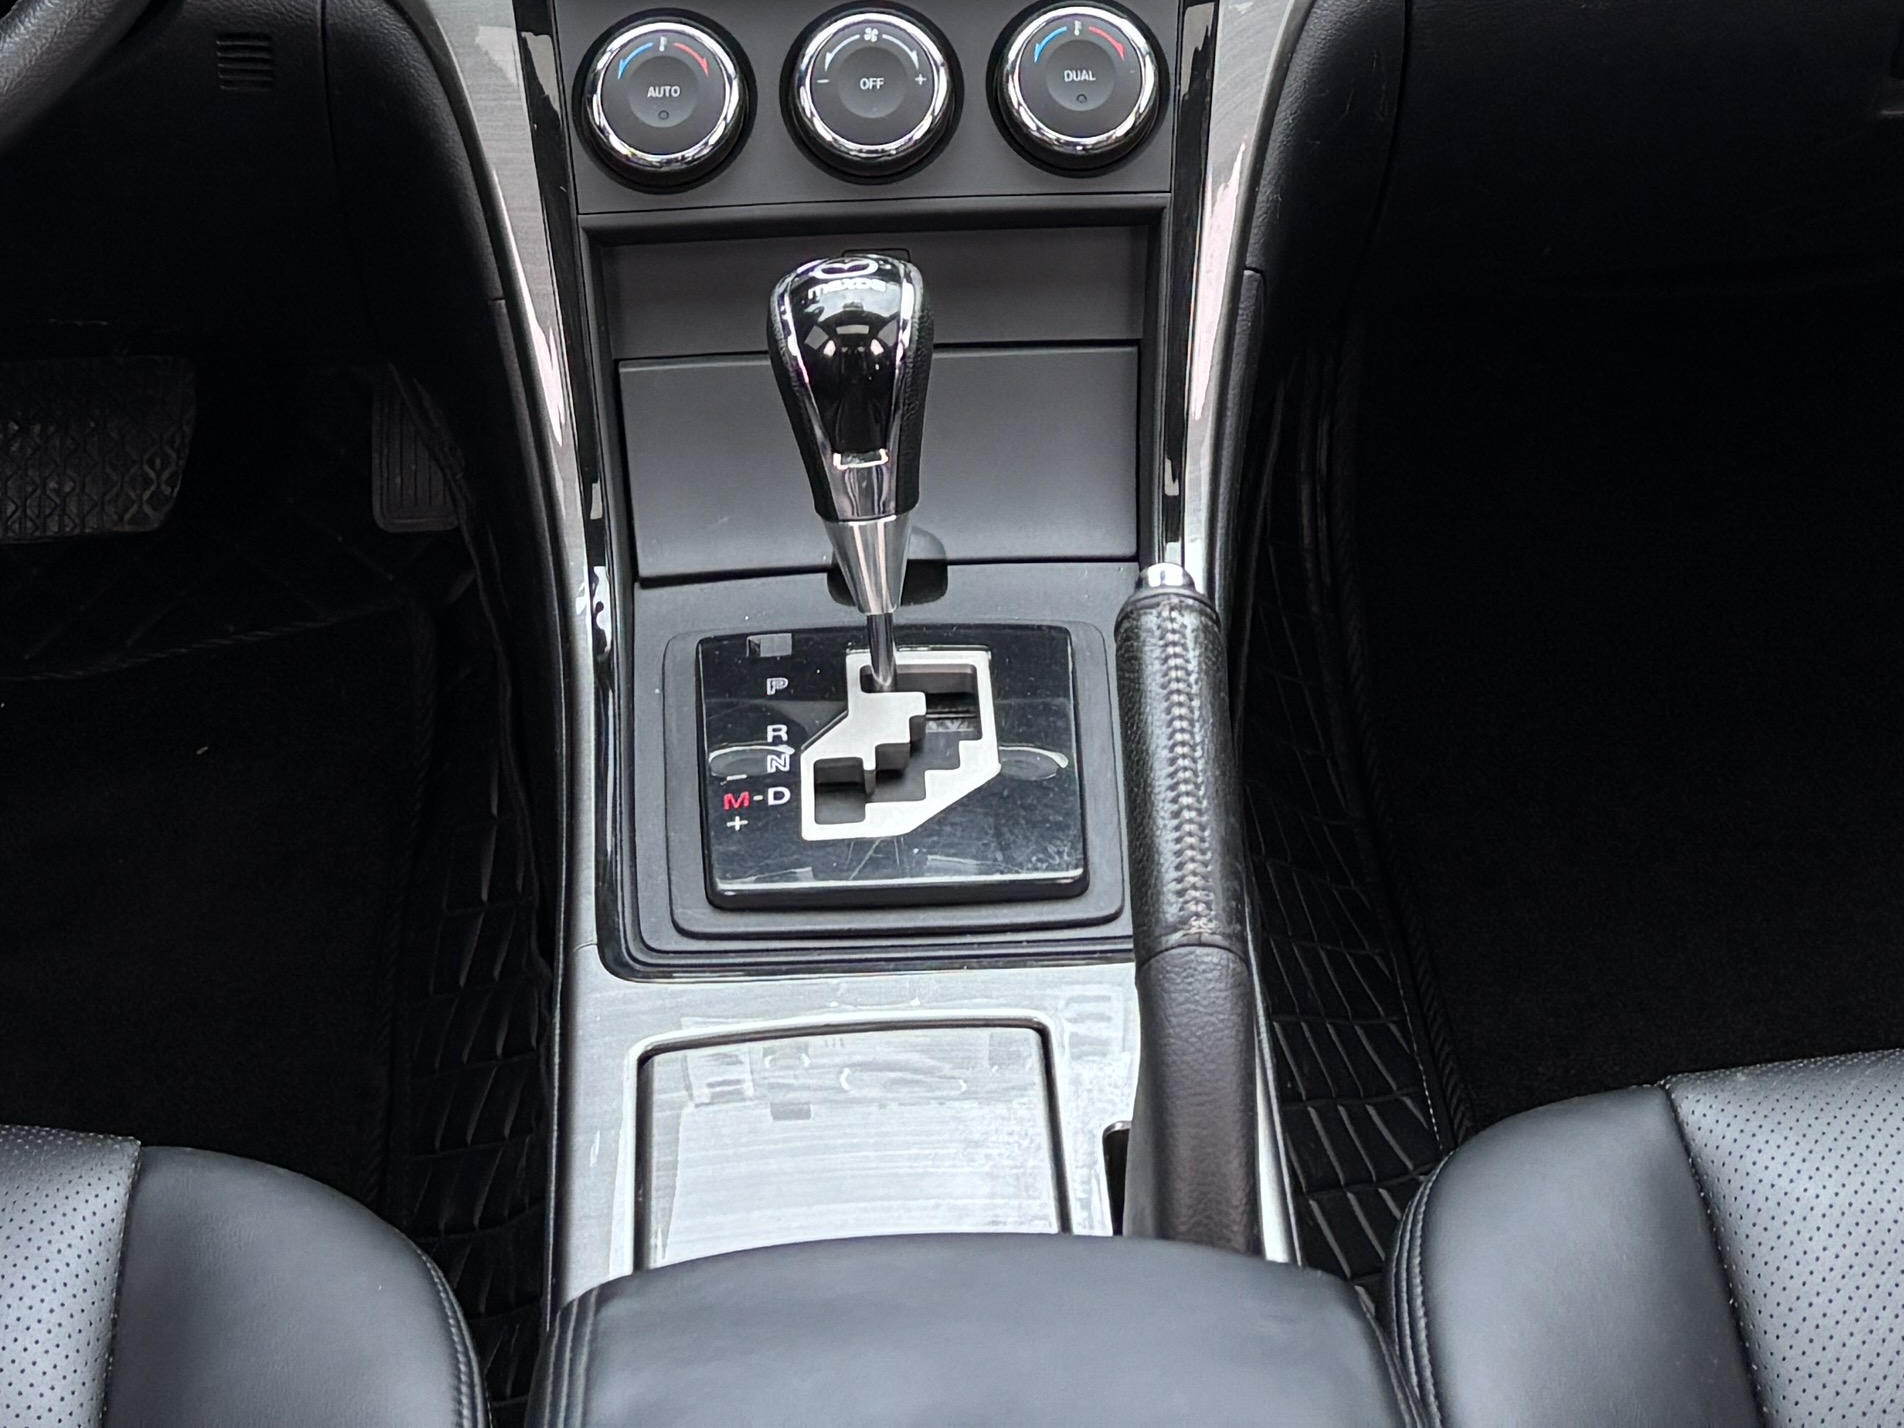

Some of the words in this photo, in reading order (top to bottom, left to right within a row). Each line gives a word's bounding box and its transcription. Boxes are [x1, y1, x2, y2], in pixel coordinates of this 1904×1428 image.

[1064, 69, 1097, 83] DUAL
[859, 77, 885, 91] OFF
[647, 85, 681, 99] AUTO
[766, 677, 789, 696] P
[766, 724, 788, 741] R
[766, 754, 791, 773] N
